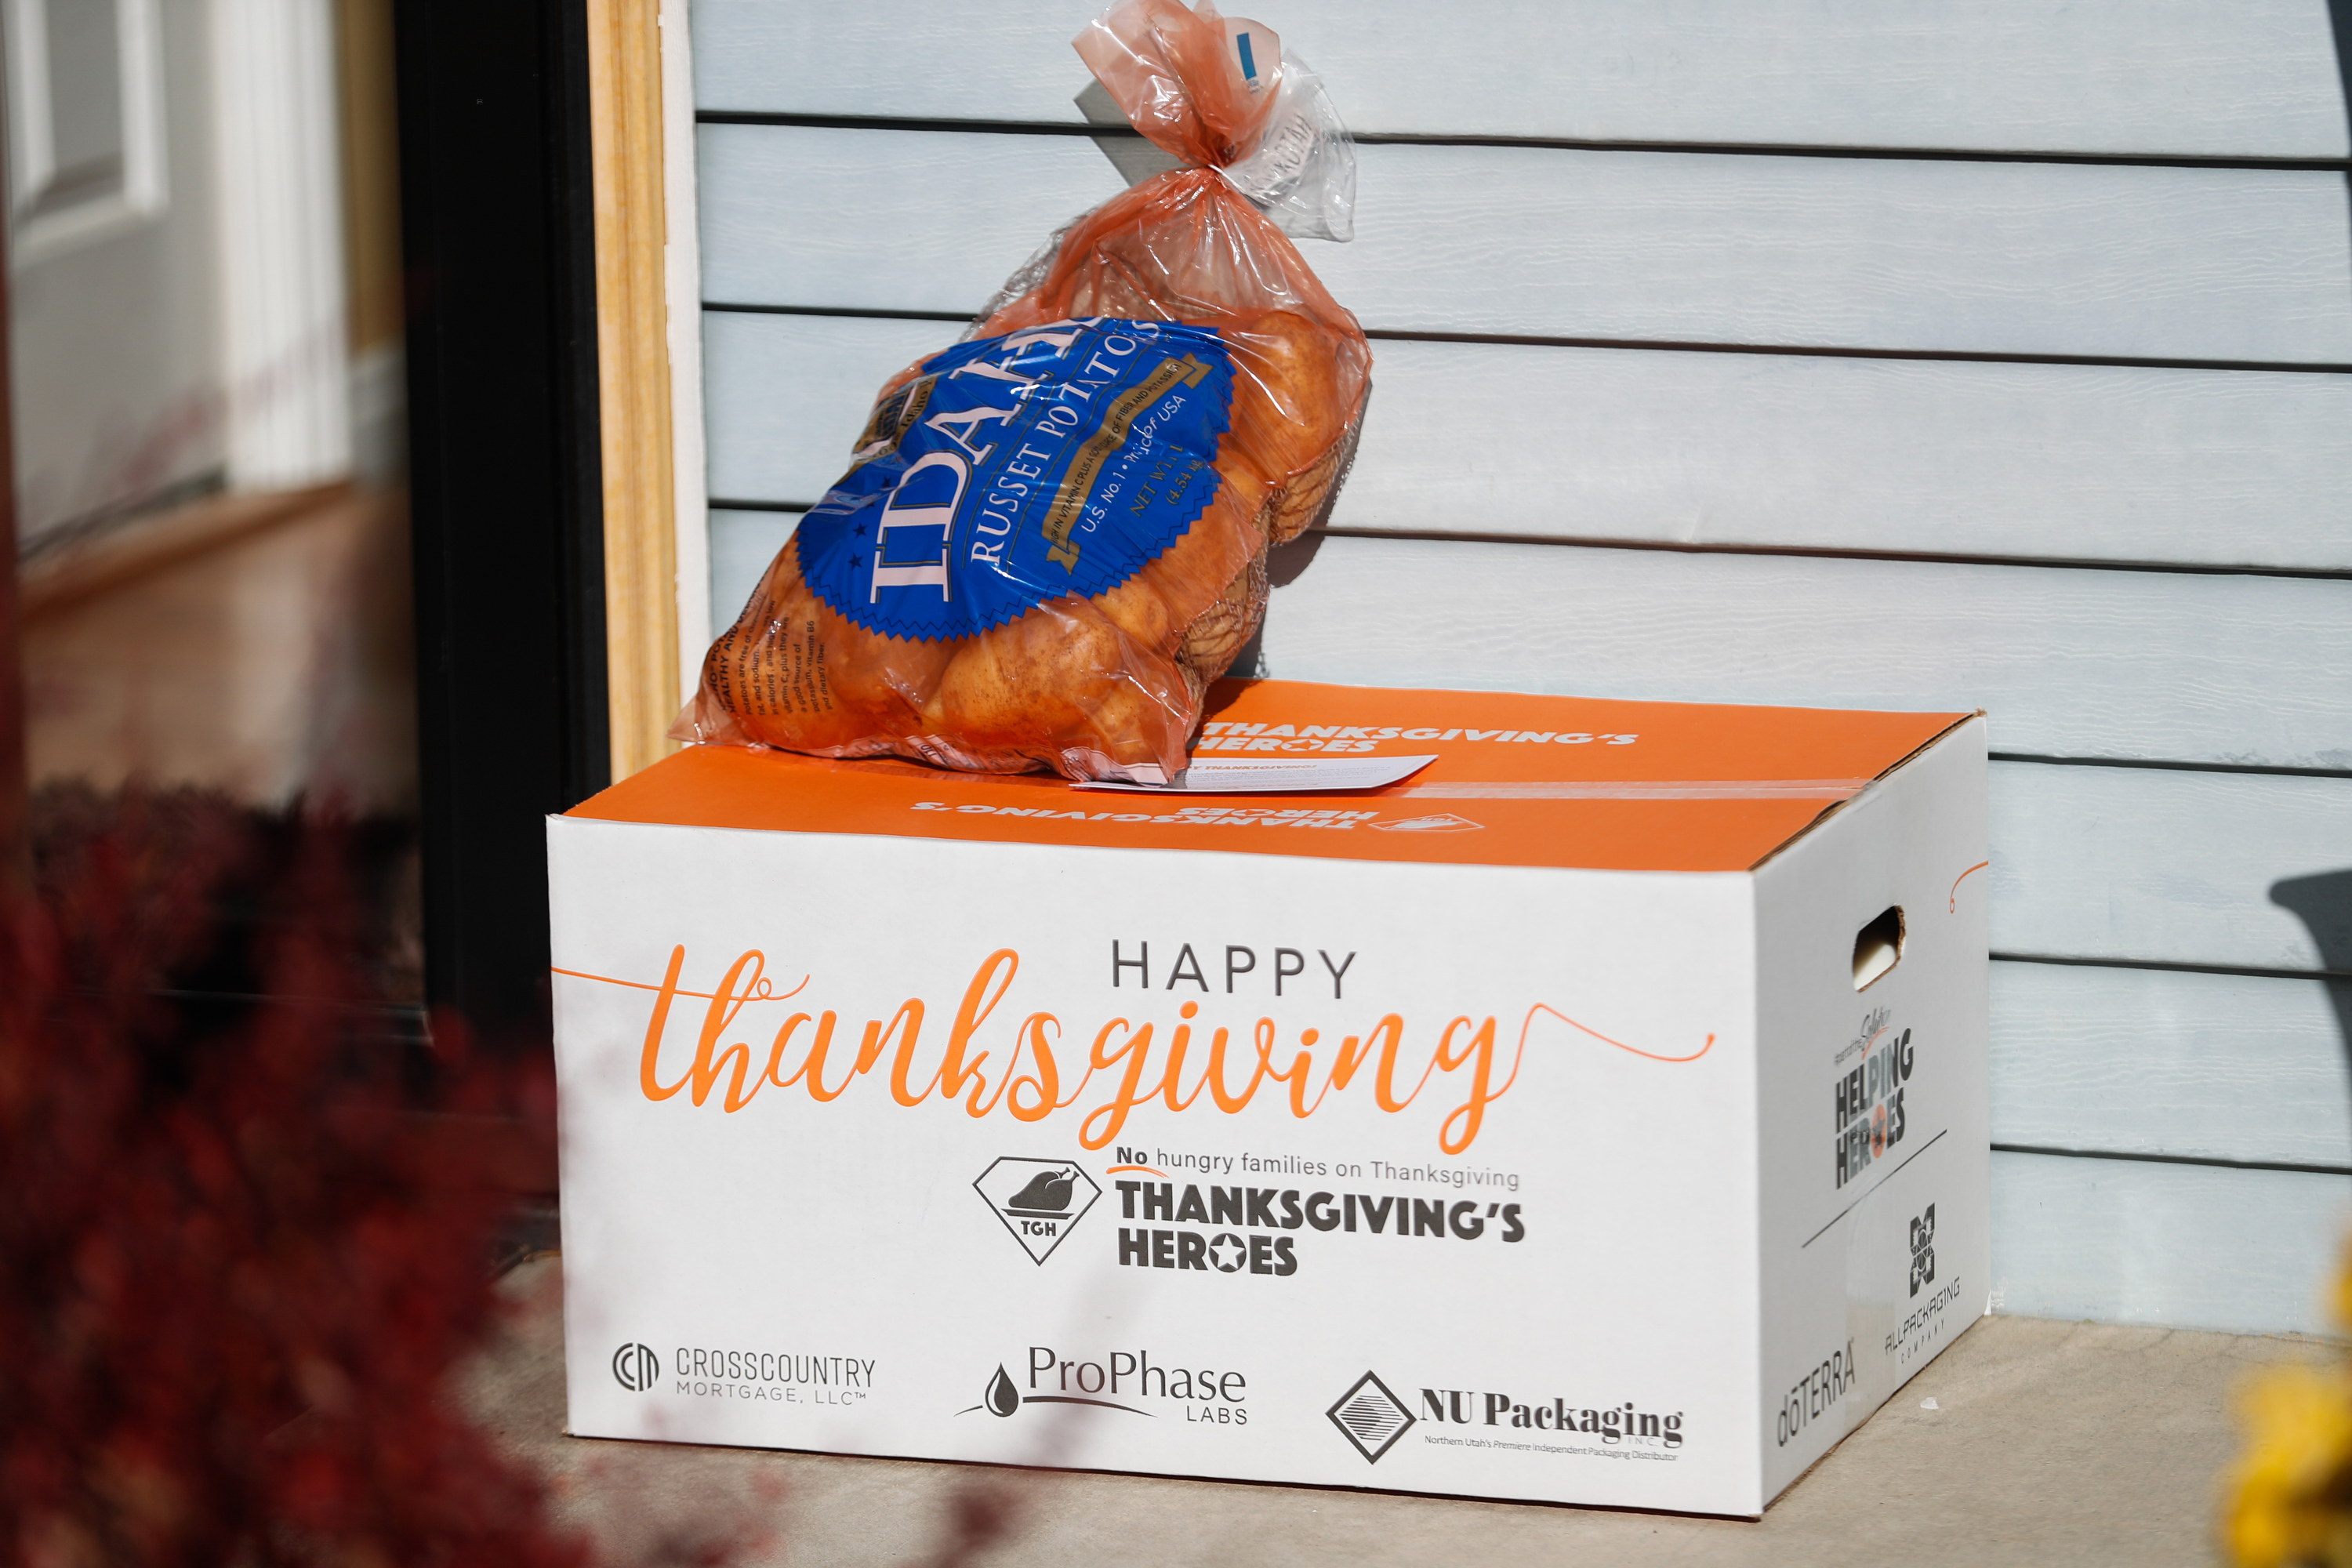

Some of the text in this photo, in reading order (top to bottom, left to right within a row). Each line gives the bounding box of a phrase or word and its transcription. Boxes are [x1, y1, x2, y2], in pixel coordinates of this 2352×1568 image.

[1116, 401, 1137, 422] FIBER
[1134, 390, 1149, 405] AND
[1112, 413, 1125, 434] OF
[971, 319, 1162, 564] RUSSET POTATOS
[1077, 461, 1092, 484] PLUS
[1081, 506, 1109, 532] U.S.
[1100, 483, 1122, 503] No.
[1112, 471, 1126, 480] 1
[1156, 394, 1187, 423] USA
[1088, 454, 1096, 463] A
[1058, 486, 1081, 518] VITAMIN
[1129, 481, 1158, 518] NET
[1164, 470, 1193, 506] (4.54
[1053, 517, 1064, 530] IN
[724, 626, 739, 652] AND
[745, 634, 753, 644] of
[807, 620, 815, 633] B6
[739, 644, 750, 661] free
[793, 644, 801, 653] of
[780, 654, 789, 672] plus
[720, 655, 737, 713] HEALTHY
[753, 685, 762, 702] and
[817, 666, 828, 695] dietary
[739, 680, 753, 715] Potatoes
[782, 685, 793, 713] vitamin
[793, 686, 806, 705] good
[1203, 721, 1639, 745] THANKSGIVING'S
[909, 801, 1356, 829] THANKSGIVING'S
[1177, 807, 1380, 821] HEROES
[1111, 938, 1357, 1000] HAPPY
[640, 943, 1715, 1155] thanksgiving
[1835, 1028, 1914, 1134] HELPING
[1836, 1087, 1906, 1190] HEROES
[1116, 1146, 1519, 1192] No hungry families on Thanksgiving
[1115, 1180, 1525, 1243] THANKSGIVING'S
[1021, 1220, 1057, 1237] TGH
[1118, 1227, 1298, 1276] HEROES
[1885, 1276, 1960, 1356] ALLPACKAGING
[1900, 1317, 1945, 1364] COMPANY
[676, 1347, 876, 1388] CROSSCOUNTRY
[1029, 1346, 1246, 1403] ProPhase
[676, 1380, 804, 1404] MORTGAGE,
[1186, 1405, 1248, 1425] LABS
[1419, 1388, 1684, 1449] NU Packaging
[1424, 1435, 1679, 1461] Northern Utah's Premiere Independent Packaging Distributor
